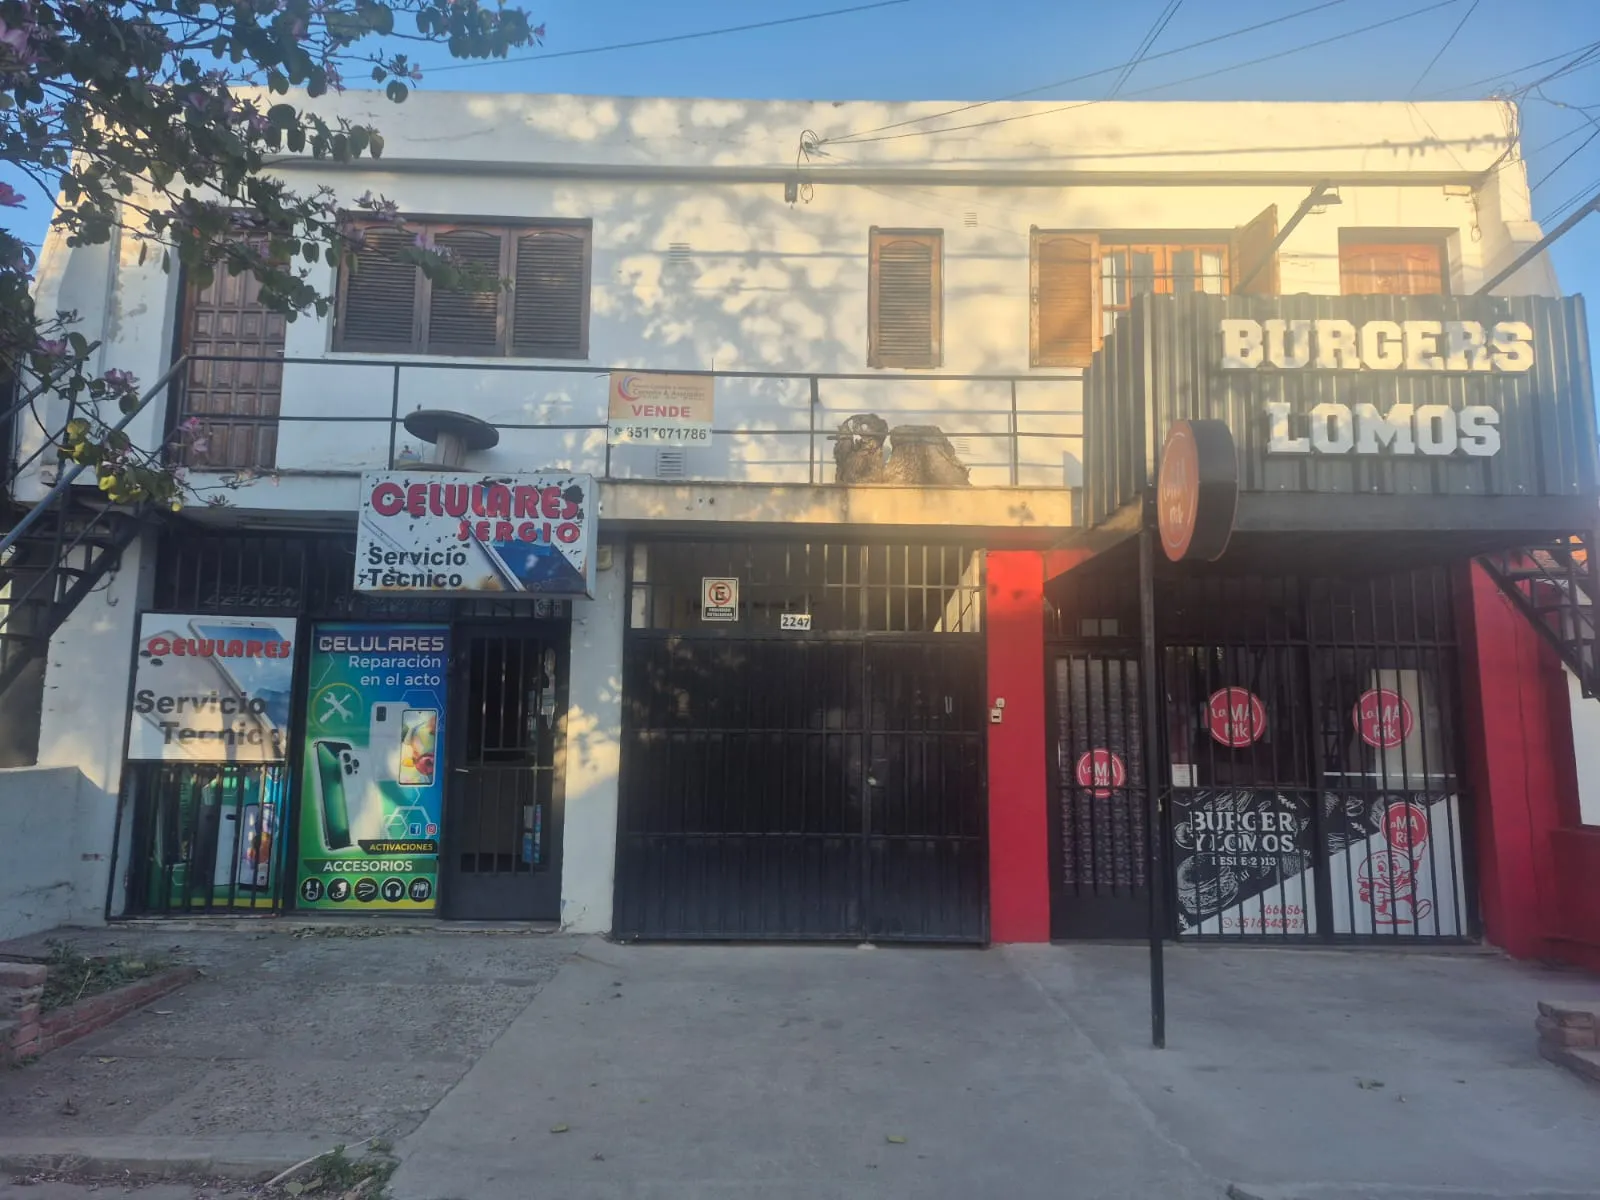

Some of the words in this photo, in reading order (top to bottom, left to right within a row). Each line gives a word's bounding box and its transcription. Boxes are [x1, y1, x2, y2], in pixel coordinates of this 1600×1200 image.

[1219, 319, 1534, 371] BURGERS
[631, 404, 691, 418] VENDE
[1267, 402, 1501, 456] LOMOS
[371, 482, 580, 519] CELULARES
[457, 520, 581, 543] SERGIO
[368, 546, 467, 566] Servicio
[782, 616, 810, 628] 2247
[147, 637, 292, 659] CELULARES
[319, 636, 445, 652] CELULARES
[348, 655, 441, 671] Reparación
[360, 675, 380, 686] en
[385, 673, 400, 686] el
[404, 674, 441, 686] acto
[134, 689, 266, 715] Servicio
[1188, 811, 1295, 832] BURGER
[323, 861, 413, 872] ACCESORIOS
